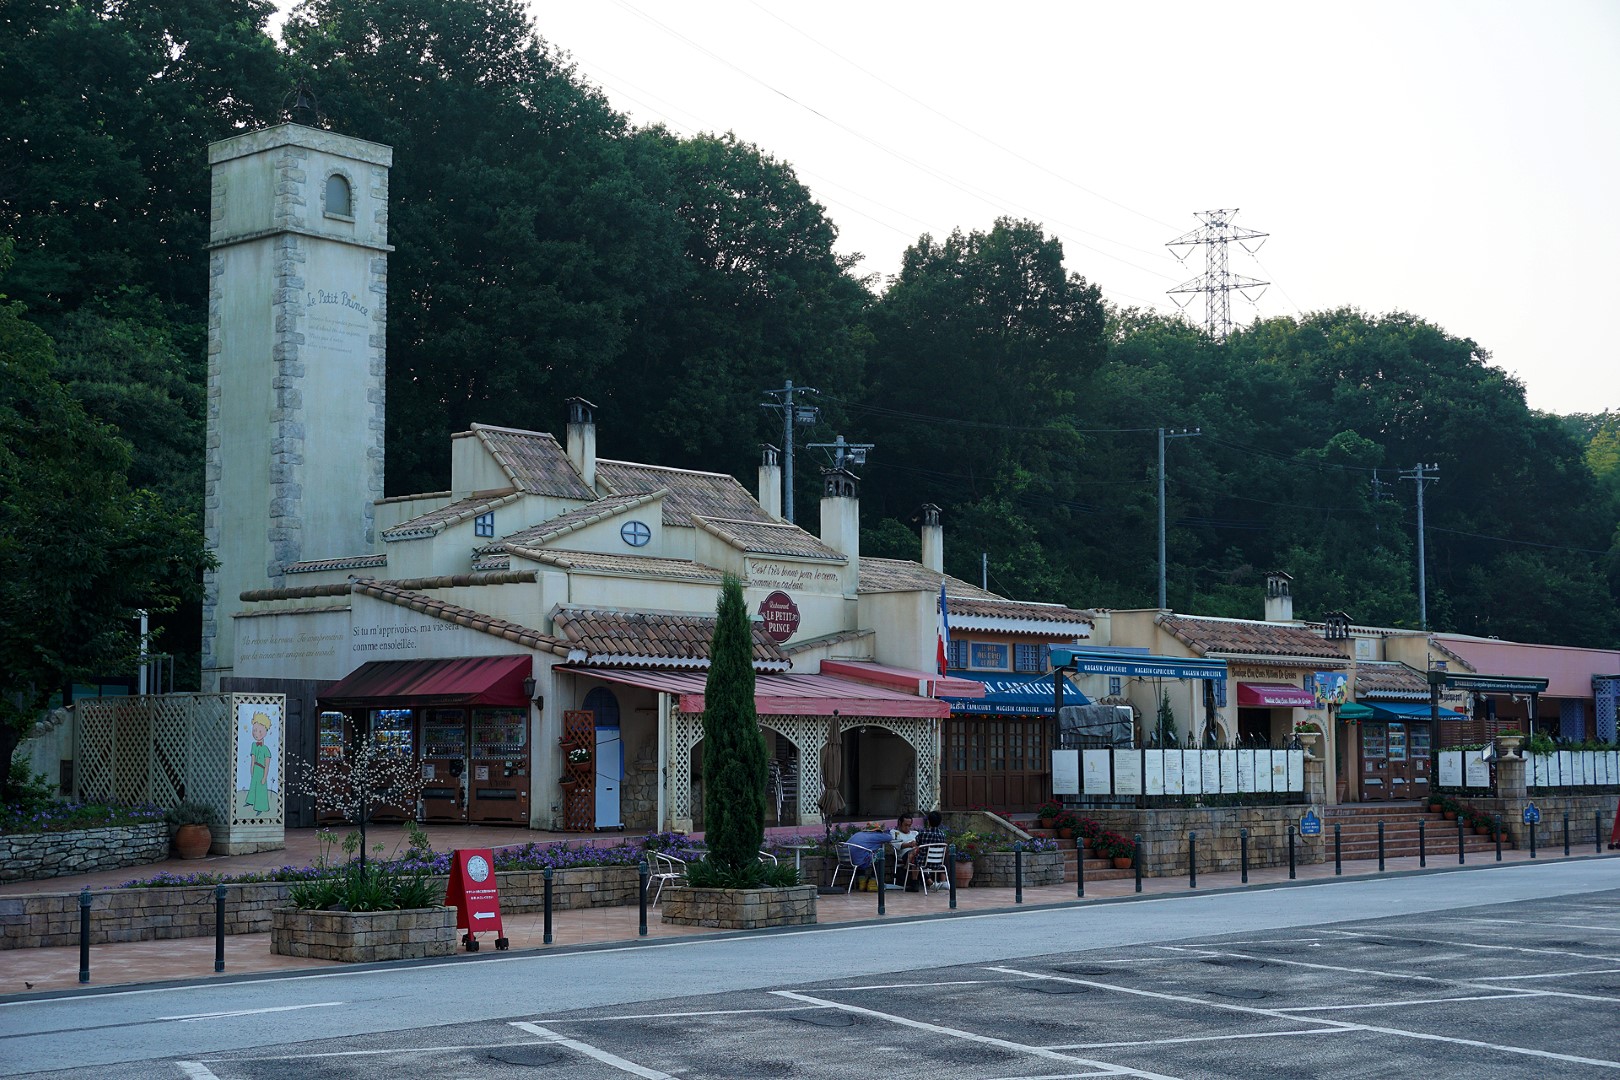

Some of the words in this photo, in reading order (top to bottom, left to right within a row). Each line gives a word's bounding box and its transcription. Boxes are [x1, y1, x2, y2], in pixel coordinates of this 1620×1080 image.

[307, 292, 316, 307] Le
[318, 289, 338, 304] Petit
[341, 291, 368, 316] Prince
[767, 611, 775, 620] LE
[775, 611, 791, 621] PETIT
[353, 625, 360, 637] Si
[361, 627, 368, 636] tu
[421, 624, 432, 632] ma
[433, 621, 444, 631] vie
[768, 622, 790, 633] PRINCE
[353, 642, 378, 652] comme
[1320, 683, 1344, 699] 夏休み
